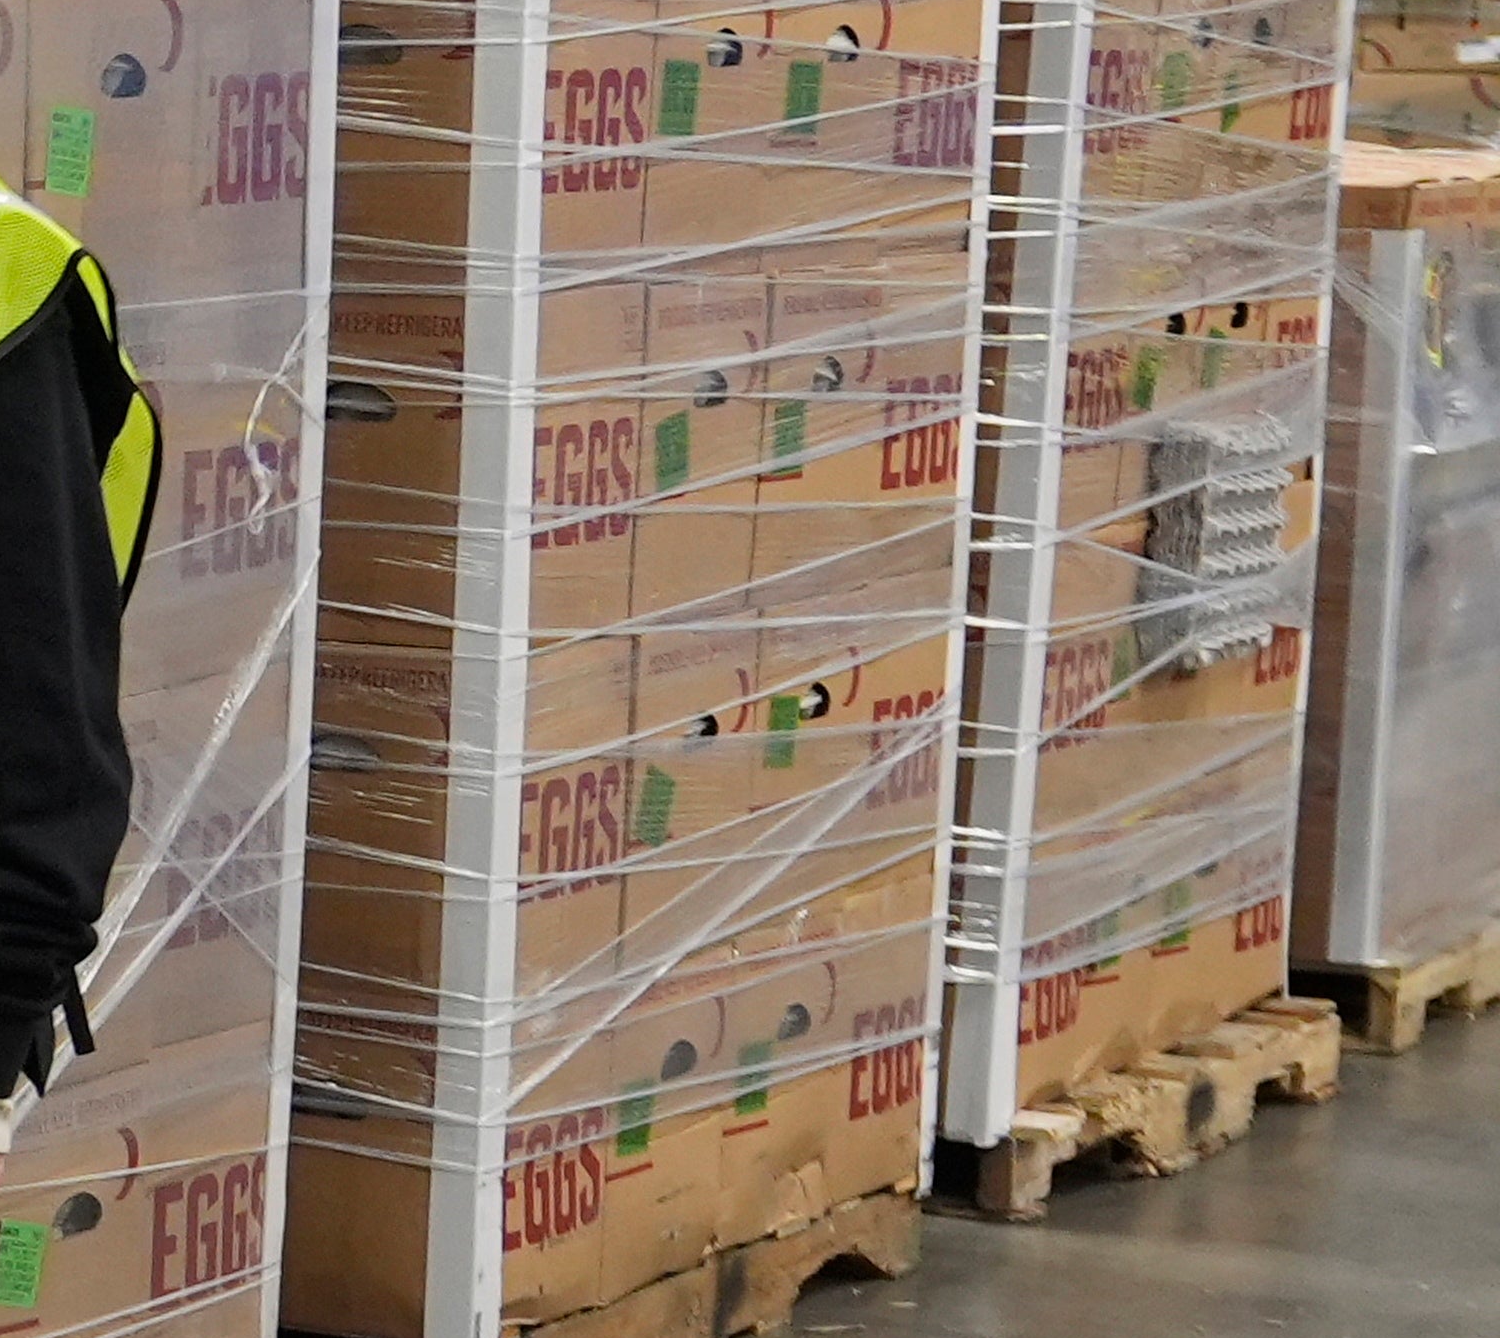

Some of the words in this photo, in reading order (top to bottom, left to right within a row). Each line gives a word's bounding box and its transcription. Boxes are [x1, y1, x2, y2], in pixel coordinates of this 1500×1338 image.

[201, 72, 309, 206] GGS
[543, 69, 647, 195] EGGS
[533, 417, 635, 550] EGGS
[517, 766, 620, 903] EGGS
[502, 1110, 605, 1251] EGGS
